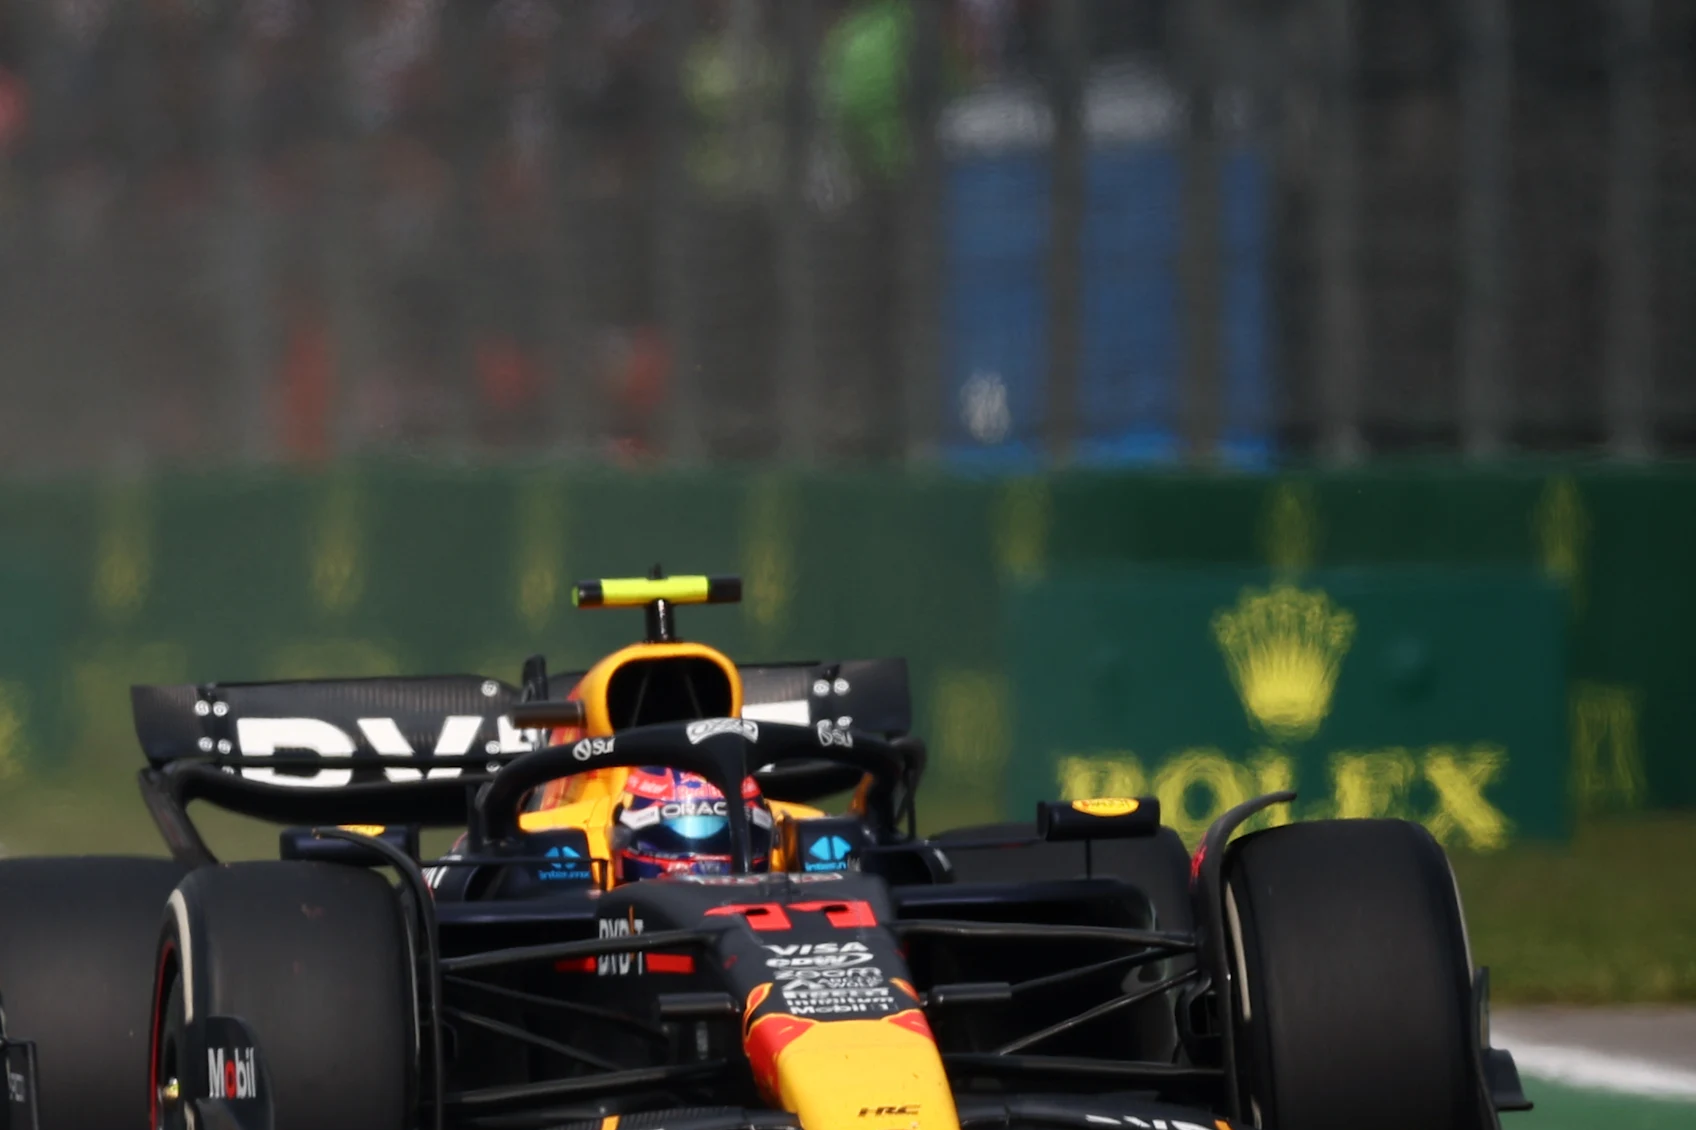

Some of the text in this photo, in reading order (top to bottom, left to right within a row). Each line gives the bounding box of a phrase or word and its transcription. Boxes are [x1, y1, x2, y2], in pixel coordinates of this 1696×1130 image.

[661, 801, 727, 816] ORAC
[704, 900, 878, 931] 11
[760, 941, 869, 956] VISA
[789, 1003, 868, 1015] Mobil
[207, 1047, 257, 1099] Mobil
[857, 1105, 922, 1118] HRC
